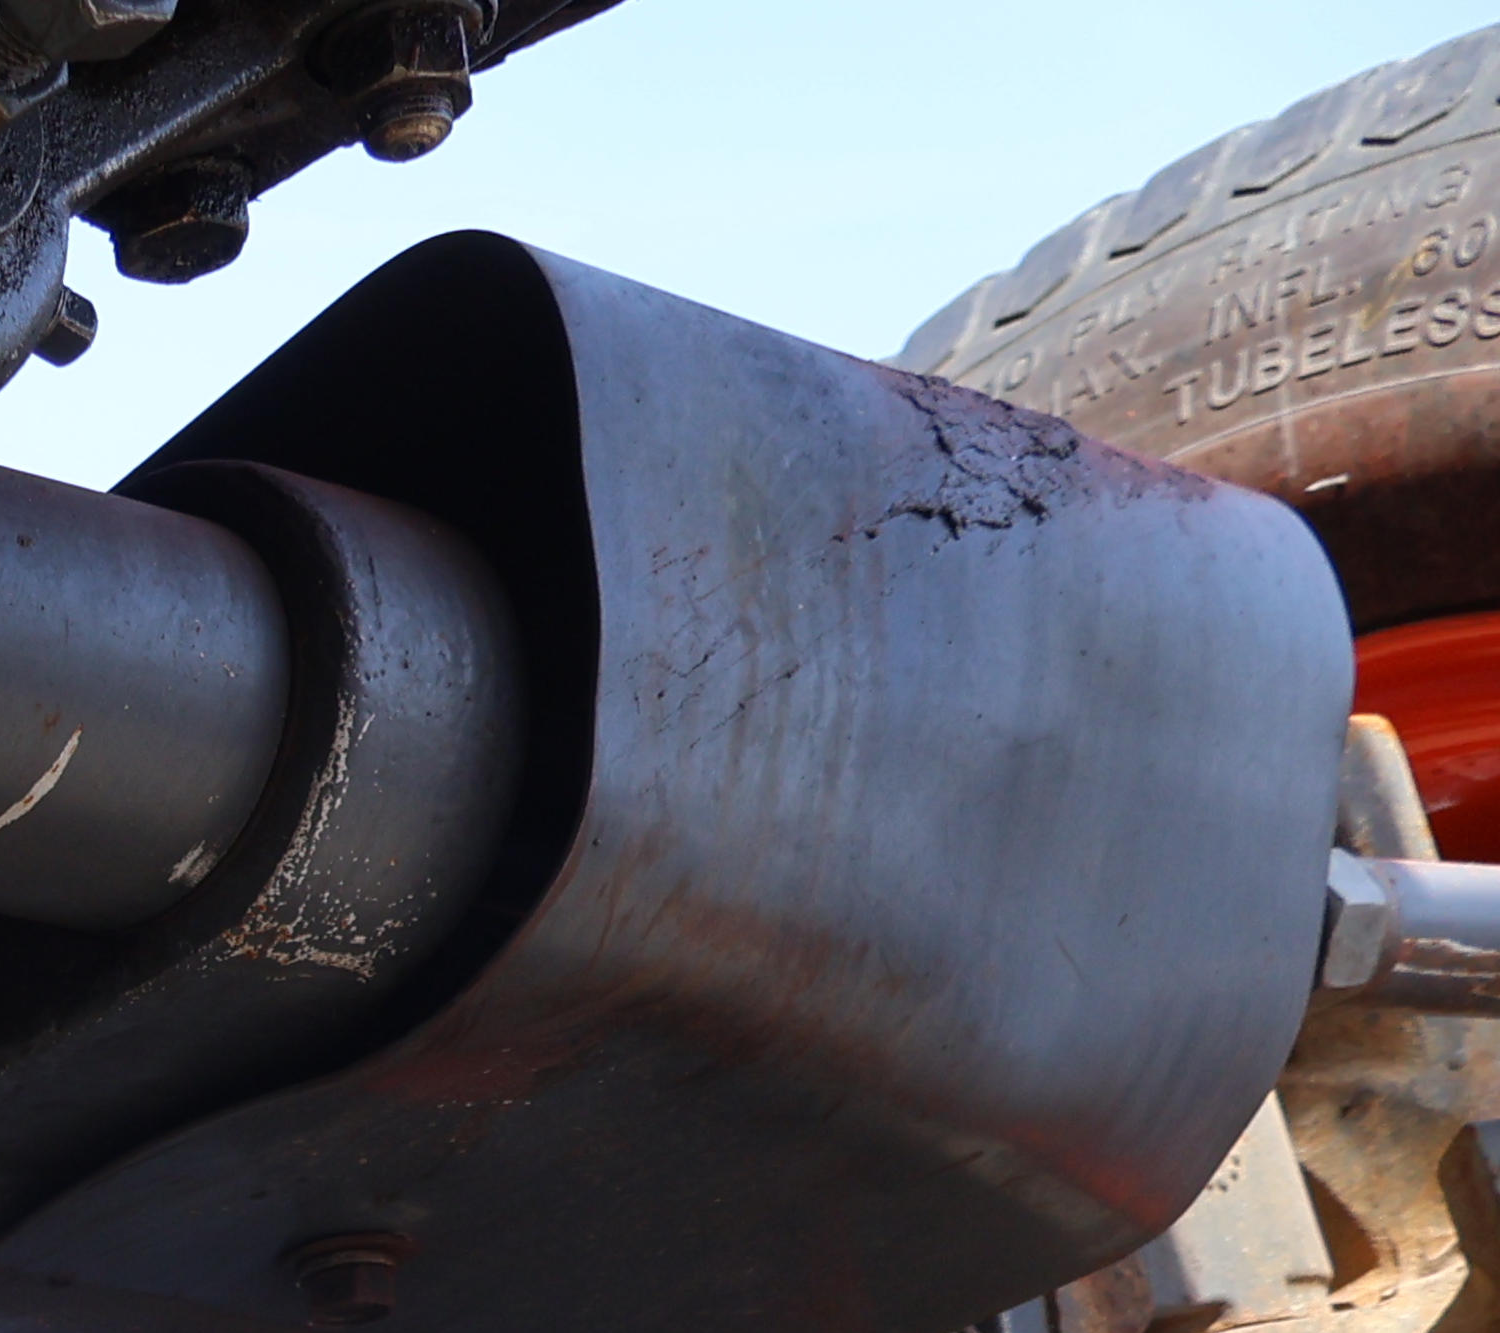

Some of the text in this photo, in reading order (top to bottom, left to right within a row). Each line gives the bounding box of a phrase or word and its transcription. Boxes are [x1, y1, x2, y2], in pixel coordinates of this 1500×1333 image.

[1065, 262, 1192, 357] PLY
[1208, 162, 1473, 284] RATING
[1412, 210, 1498, 278] 60
[1162, 285, 1500, 428] TUBELESS
